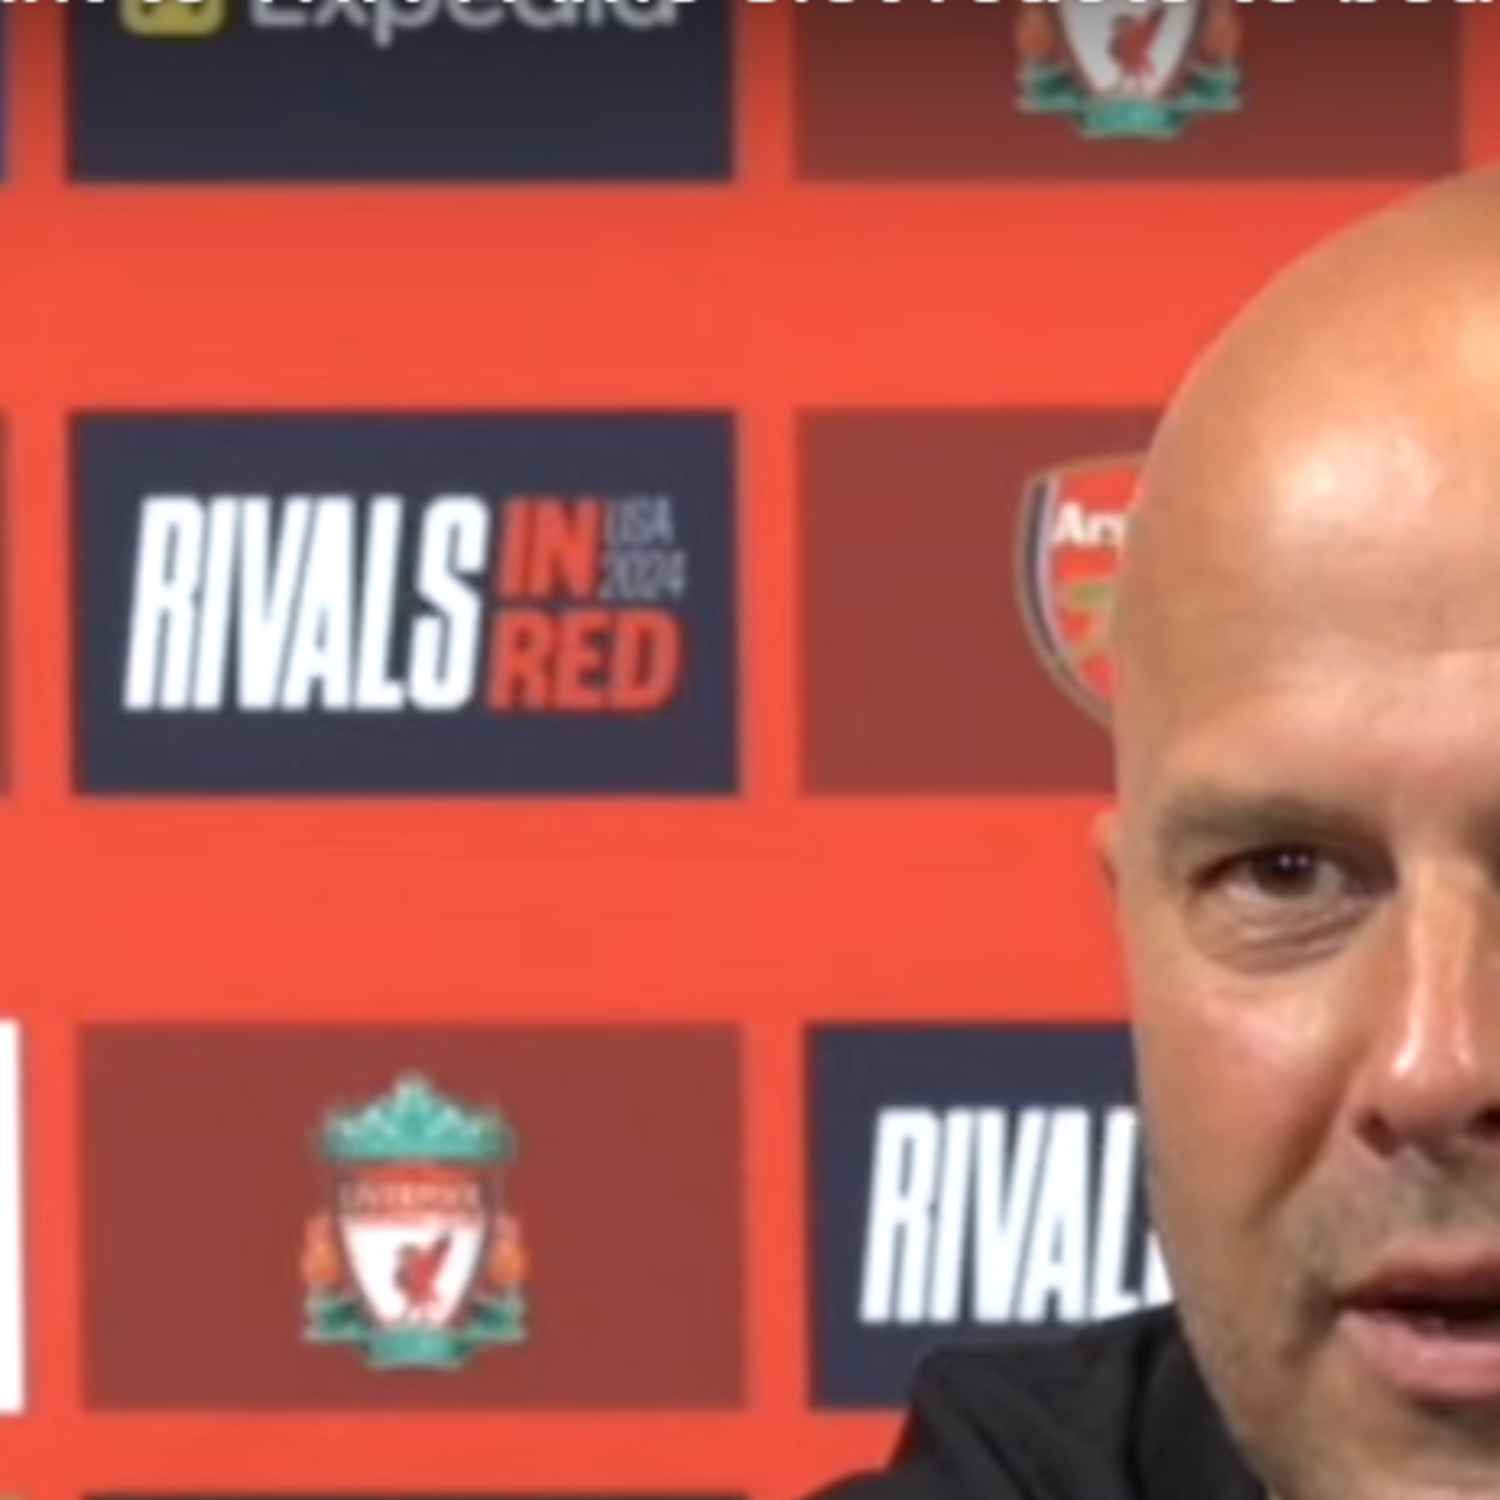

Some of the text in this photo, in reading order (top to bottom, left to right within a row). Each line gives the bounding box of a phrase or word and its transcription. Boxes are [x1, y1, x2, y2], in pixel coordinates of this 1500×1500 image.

[122, 493, 607, 712] RIVALS IN
[486, 605, 685, 713] RED
[860, 1106, 1175, 1324] RIVAL
